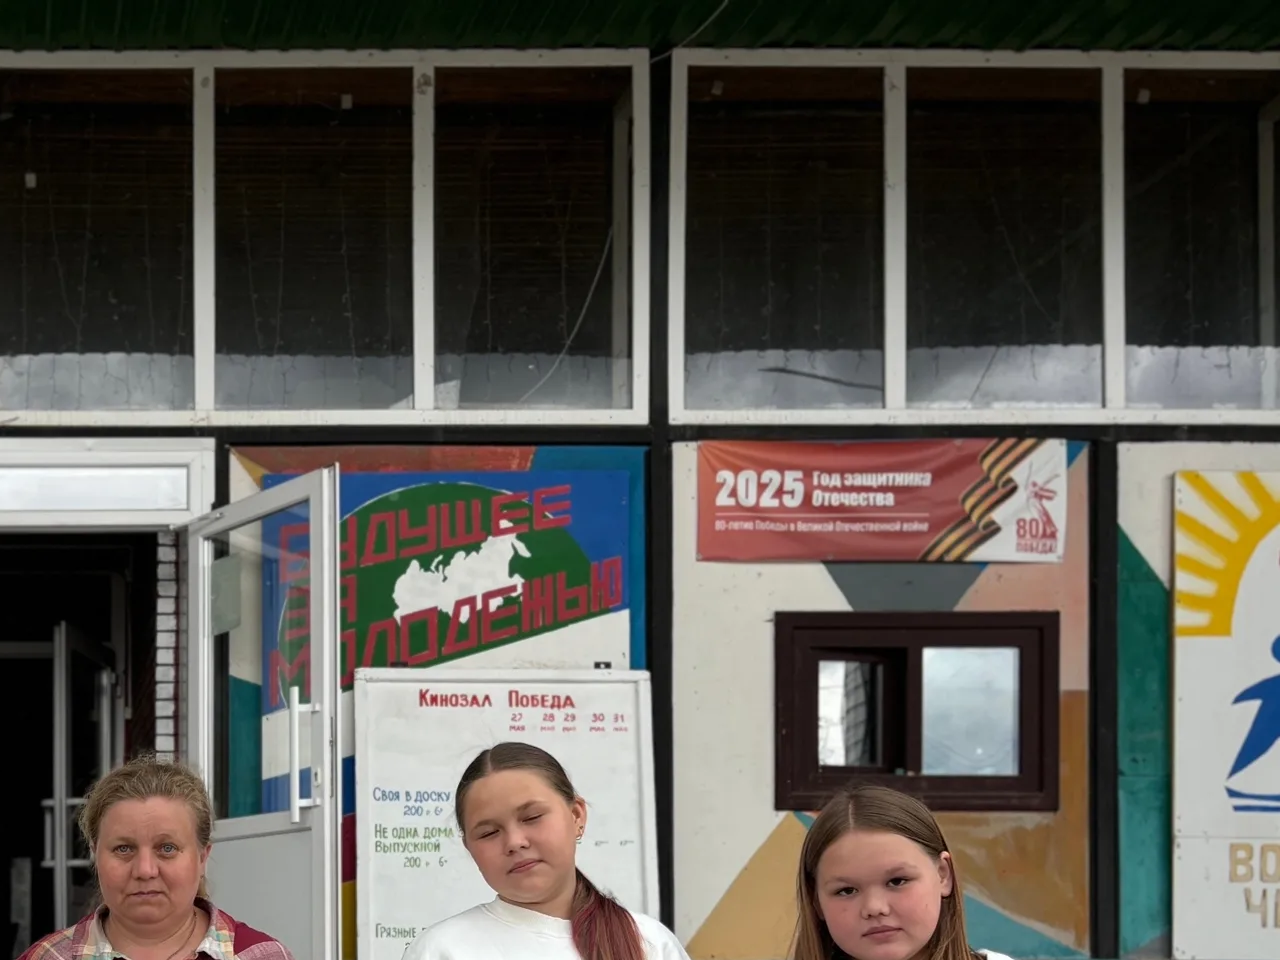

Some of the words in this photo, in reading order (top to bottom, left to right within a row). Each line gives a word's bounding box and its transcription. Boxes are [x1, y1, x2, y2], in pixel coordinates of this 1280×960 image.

[812, 471, 842, 487] Год
[844, 472, 931, 488] защитника
[715, 470, 804, 508] 2025
[812, 491, 895, 507] Отечества
[1016, 517, 1039, 539] 80
[510, 713, 523, 722] 27
[542, 713, 555, 722] 28
[563, 713, 576, 722] 29
[591, 713, 605, 722] 30
[613, 713, 625, 722] 31
[403, 805, 424, 816] 200
[403, 856, 421, 868] 200
